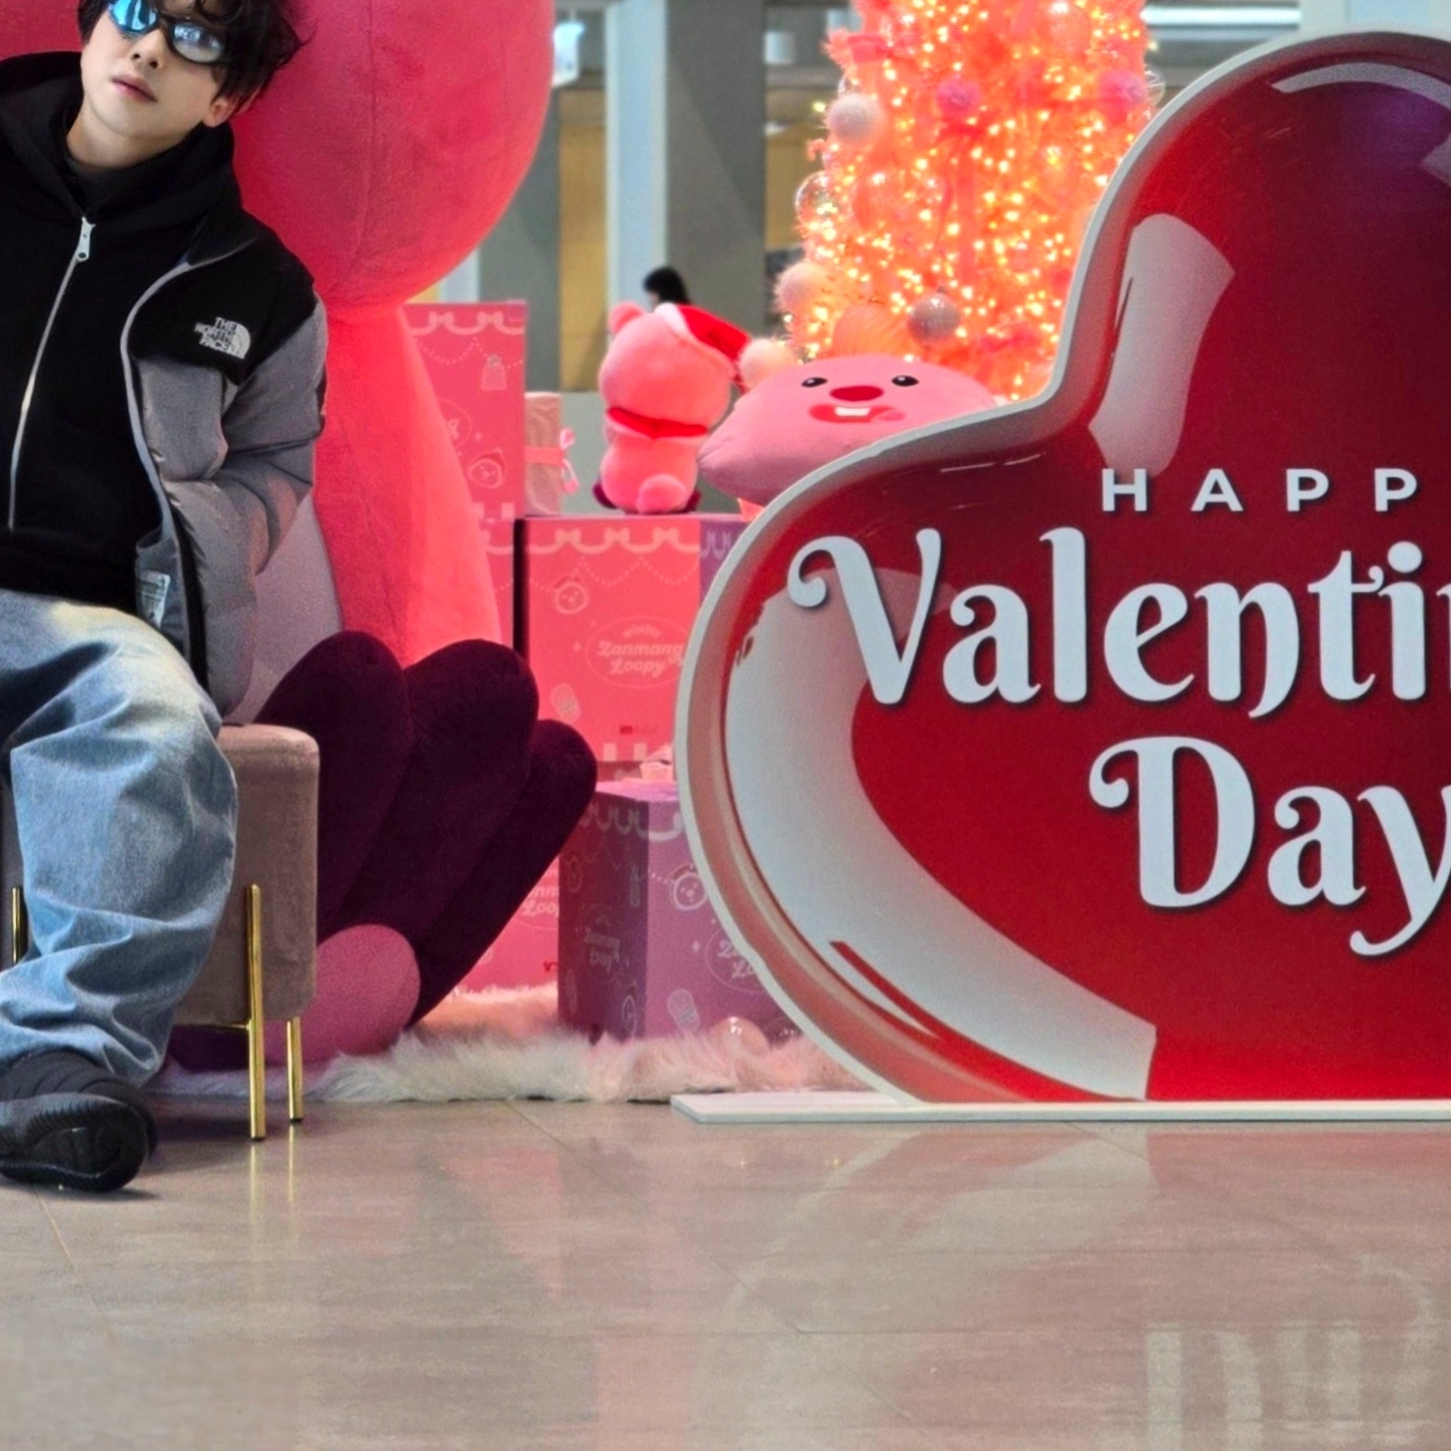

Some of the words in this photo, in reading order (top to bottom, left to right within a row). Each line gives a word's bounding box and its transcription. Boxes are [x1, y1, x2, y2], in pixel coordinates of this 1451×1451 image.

[1101, 468, 1418, 512] HAPP
[787, 527, 1451, 718] Valenti
[597, 640, 685, 667] Zanmang
[609, 657, 666, 678] Loopy
[1089, 736, 1451, 956] Day
